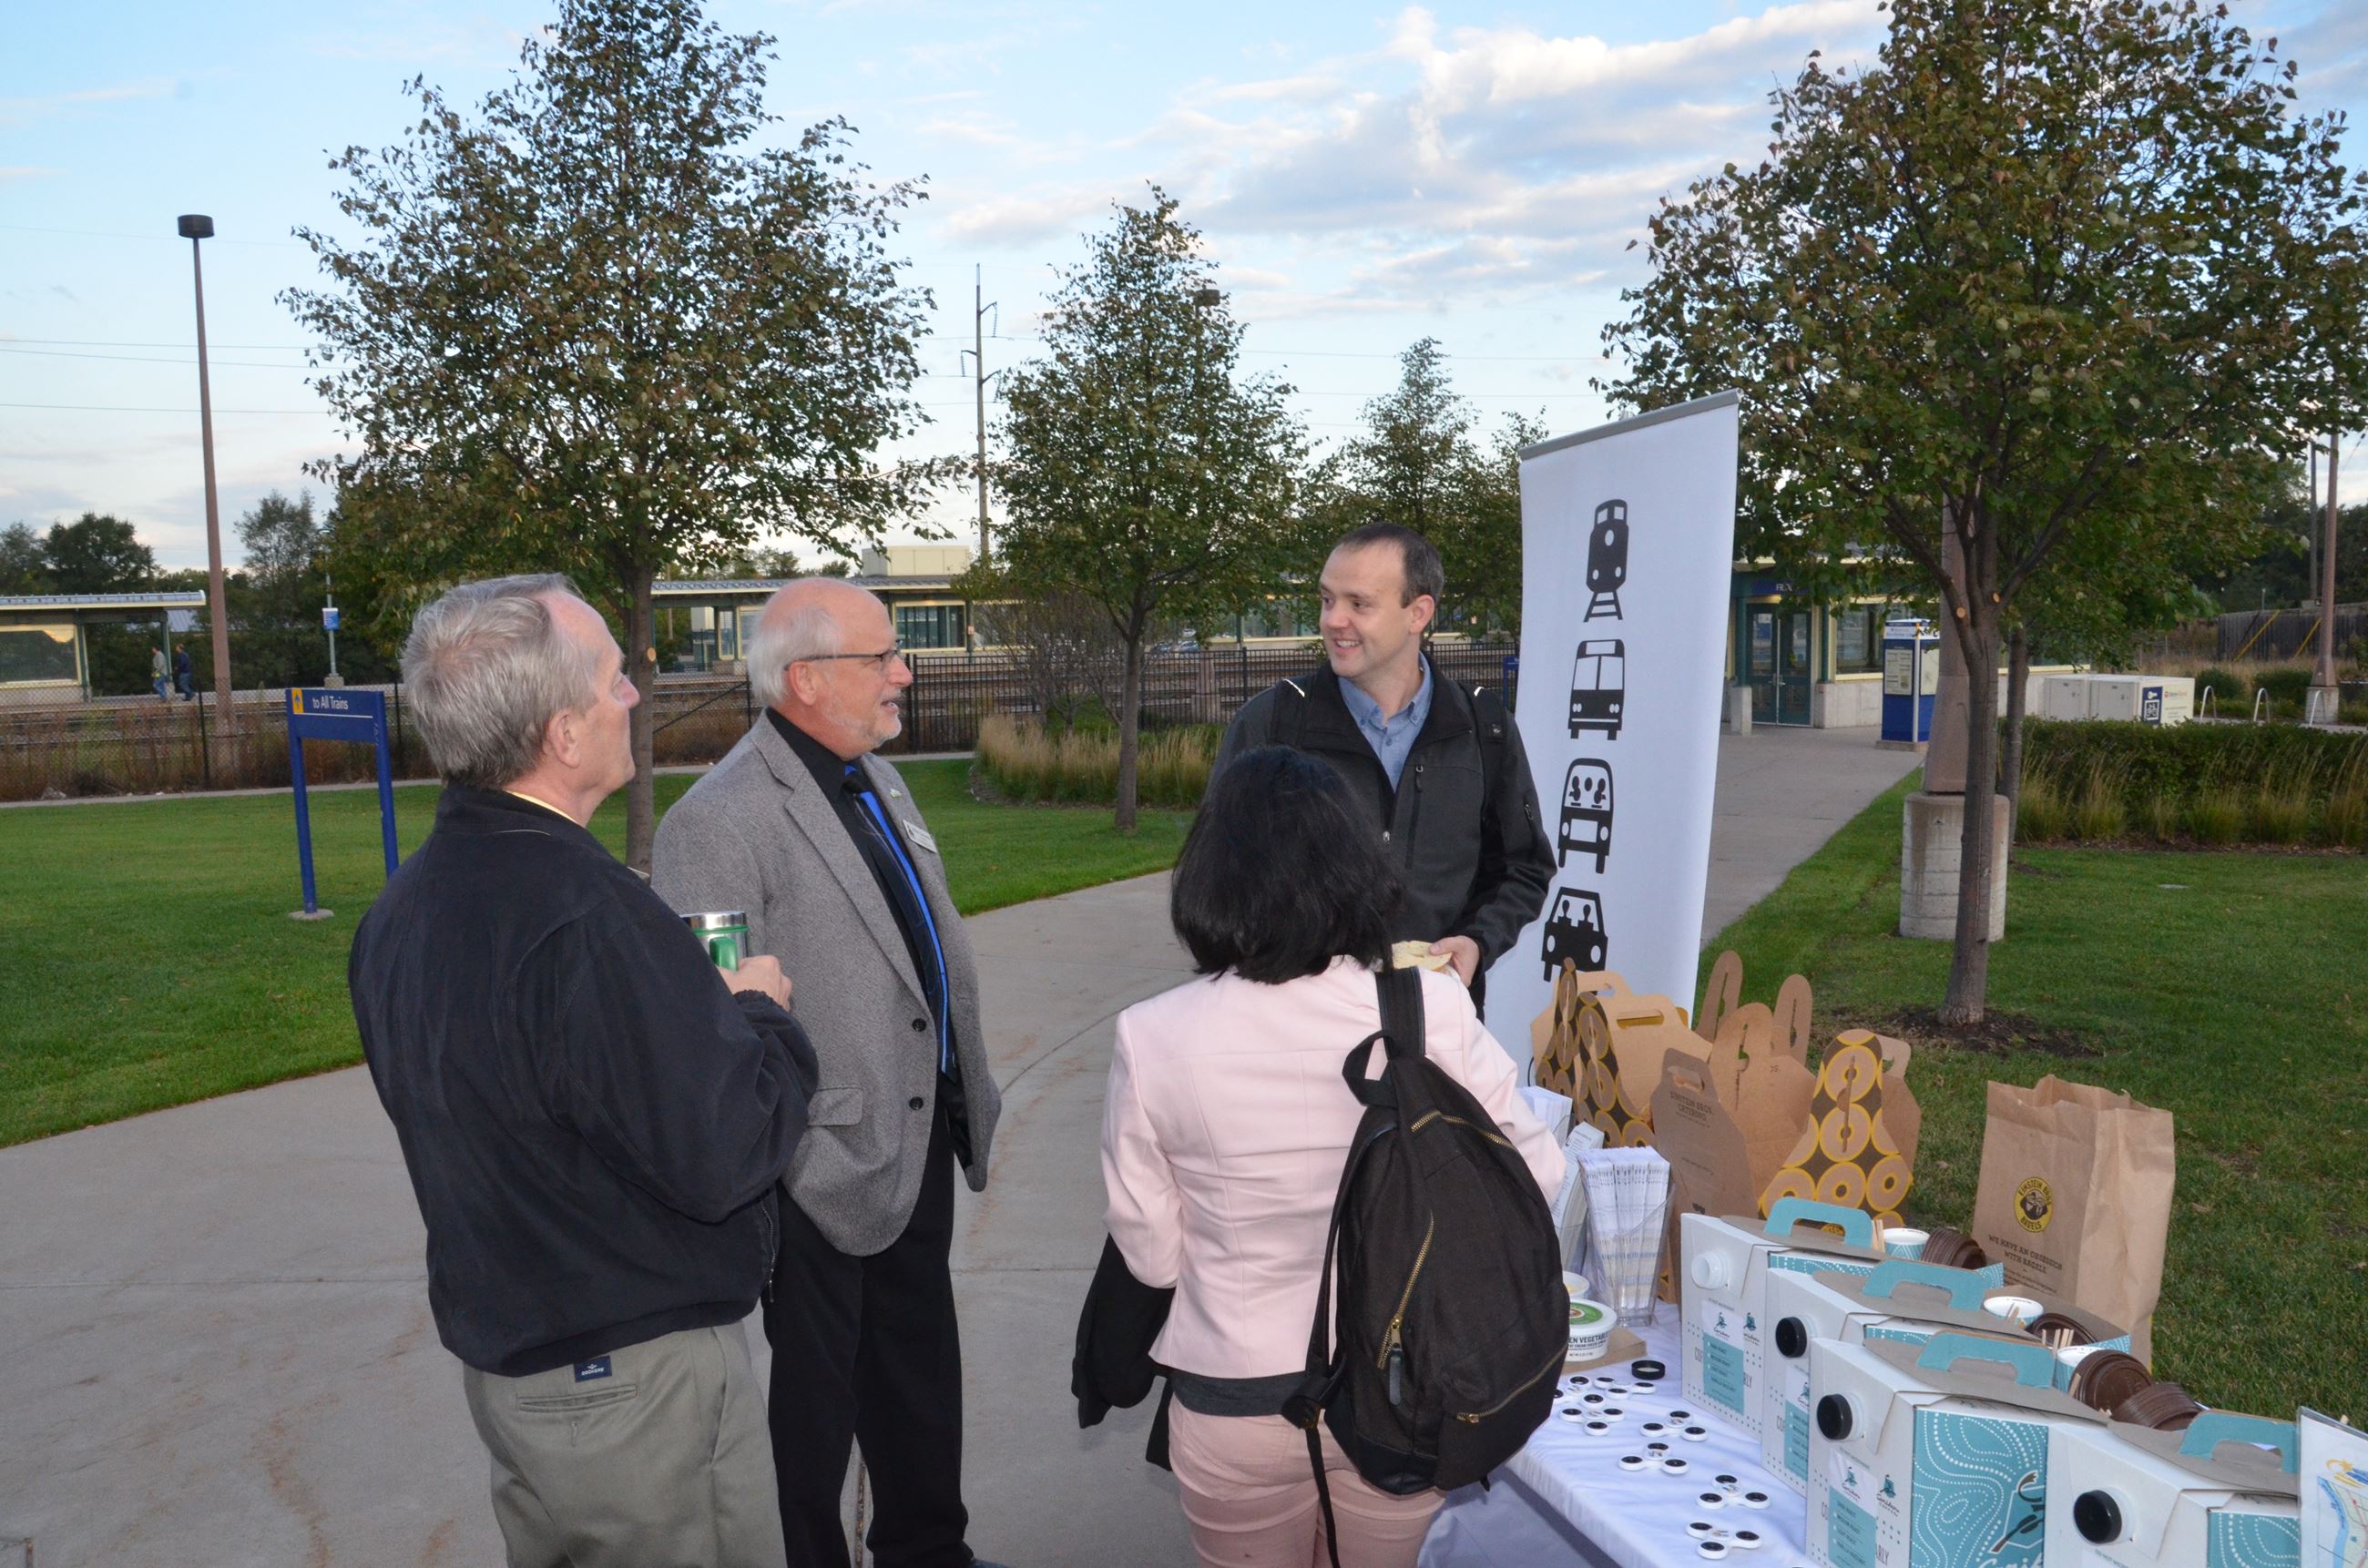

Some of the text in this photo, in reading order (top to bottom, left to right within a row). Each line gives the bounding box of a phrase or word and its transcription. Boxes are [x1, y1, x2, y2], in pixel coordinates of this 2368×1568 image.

[312, 696, 349, 709] to All Trains
[2018, 1179, 2043, 1196] EINSTEIN
[2020, 1217, 2043, 1230] BAGELS
[1988, 1234, 2063, 1271] WE HAVE AN OBSESSION
[2005, 1250, 2022, 1264] WITH
